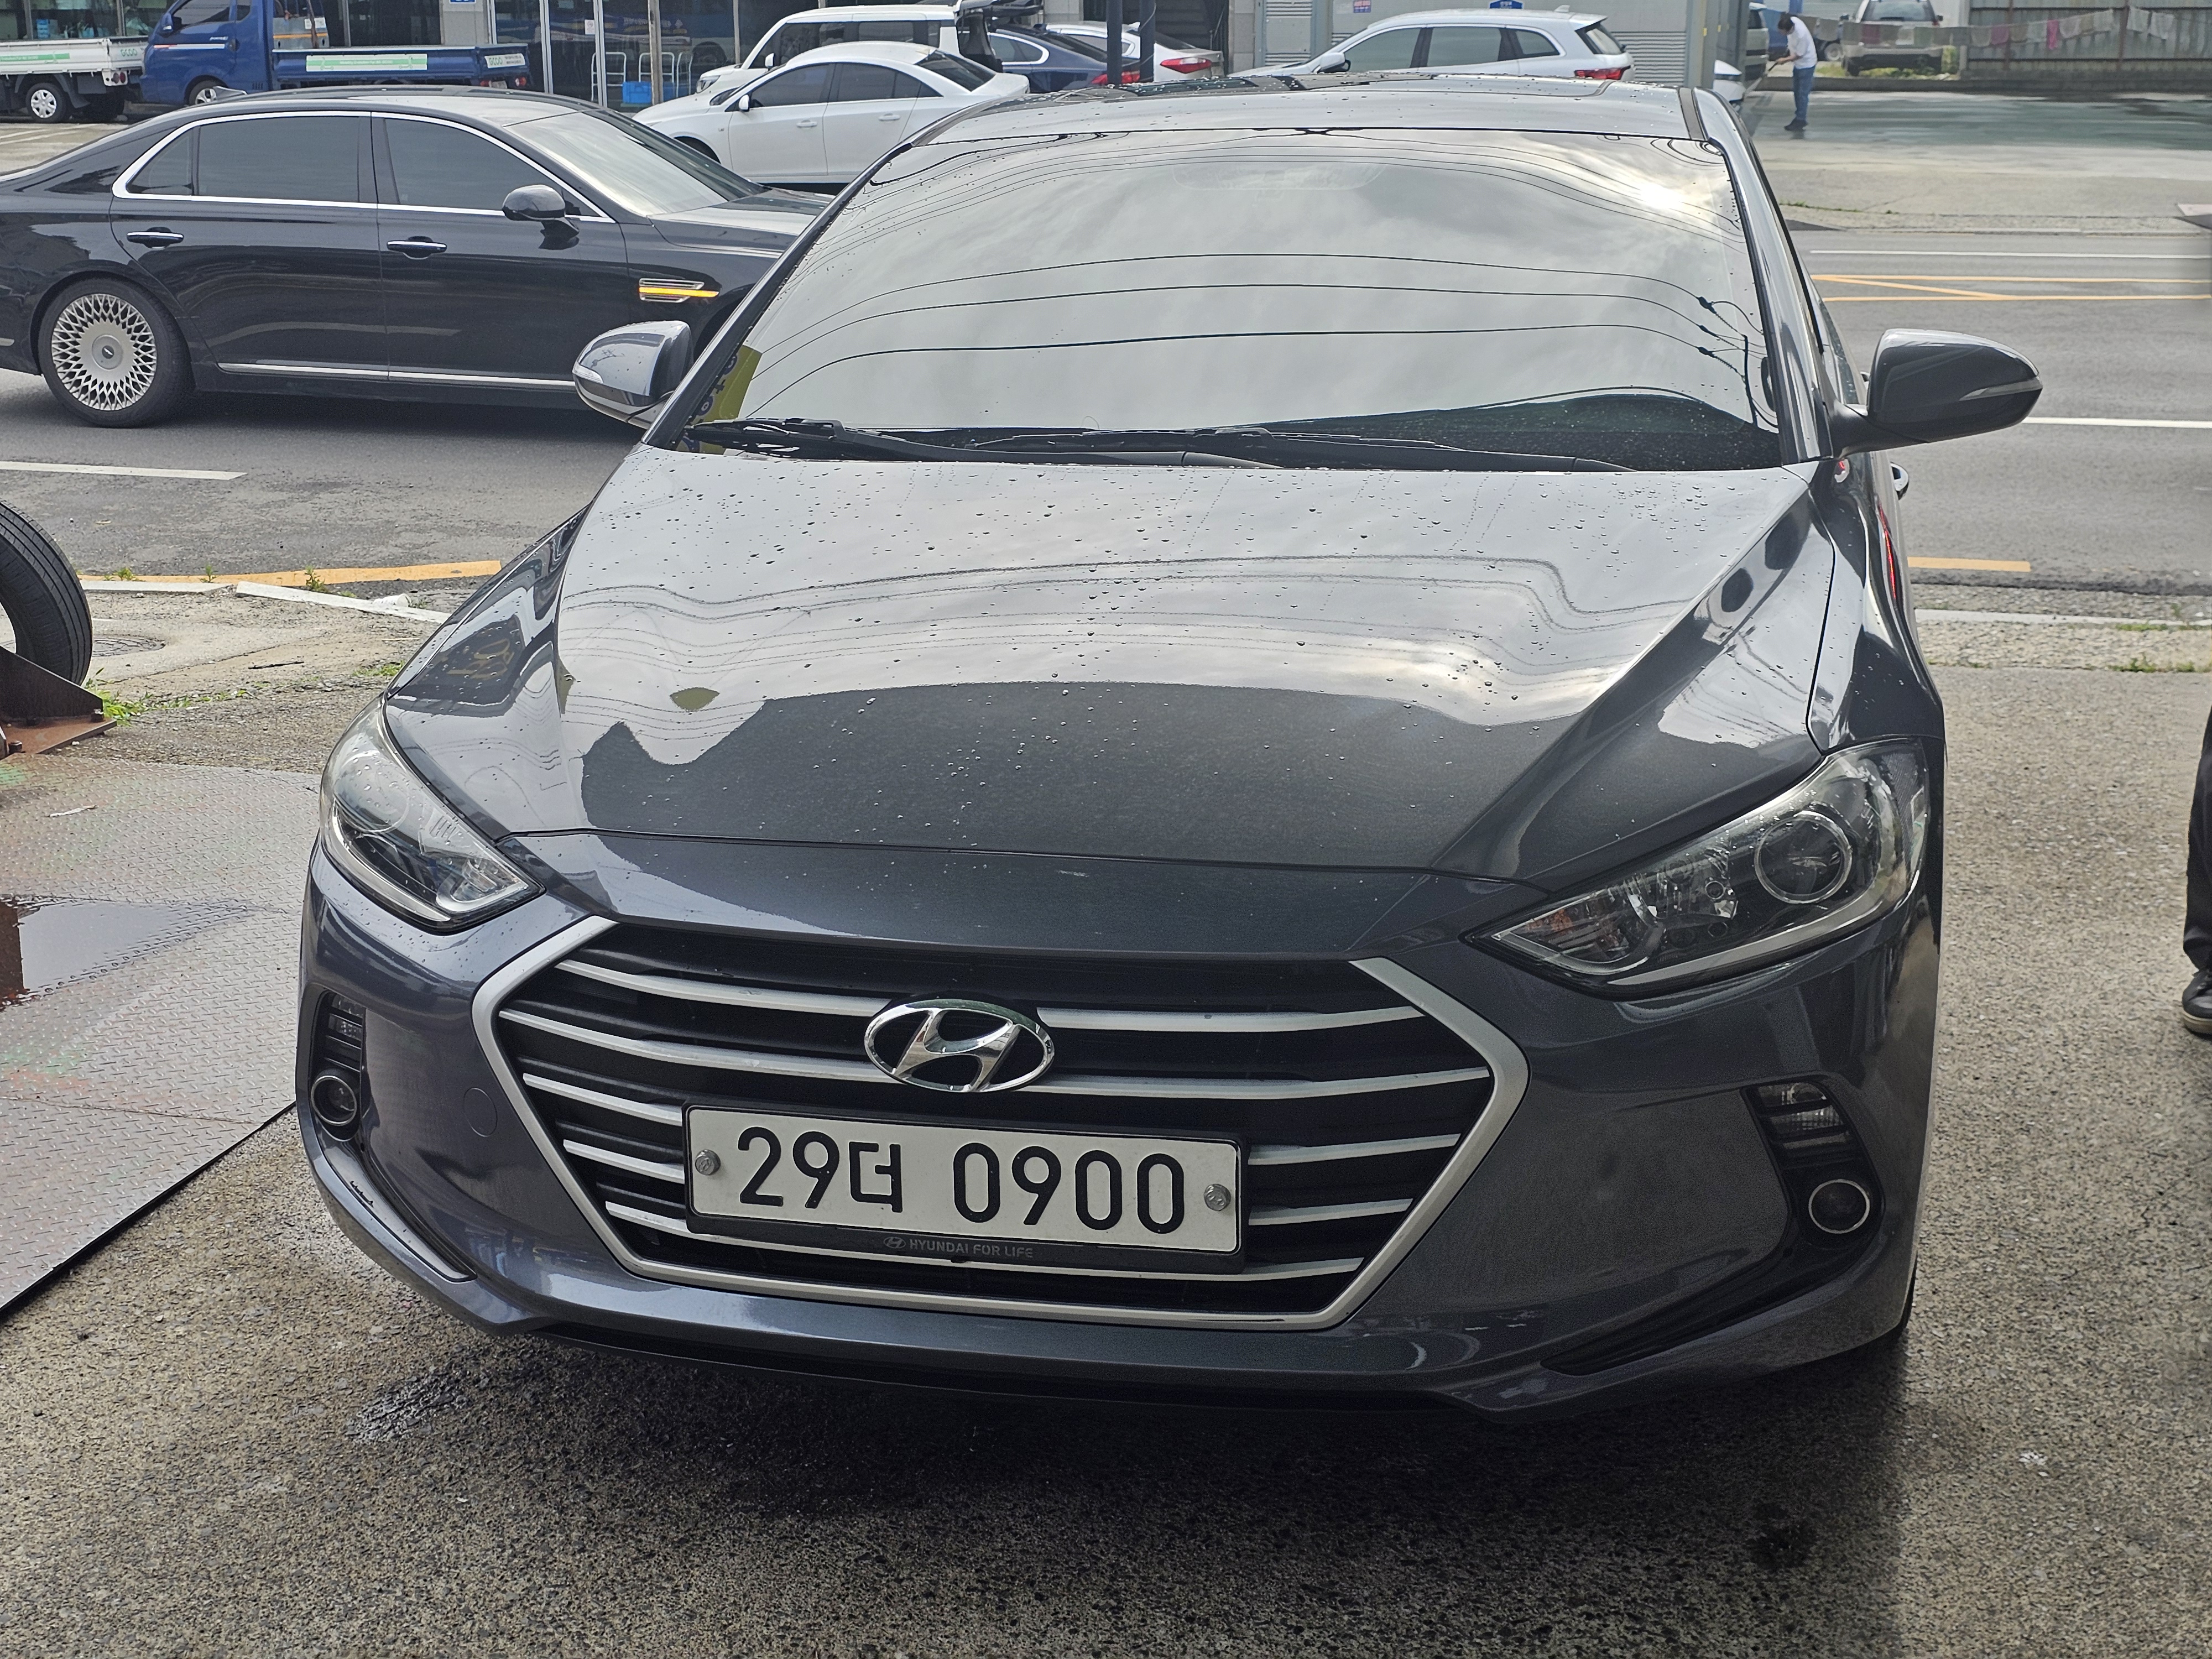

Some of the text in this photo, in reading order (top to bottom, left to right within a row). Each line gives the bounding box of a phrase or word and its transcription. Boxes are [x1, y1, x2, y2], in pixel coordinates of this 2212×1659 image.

[737, 1126, 1185, 1234] 29더 0900
[910, 1239, 1033, 1258] HYUNDAI FOR LIFE
